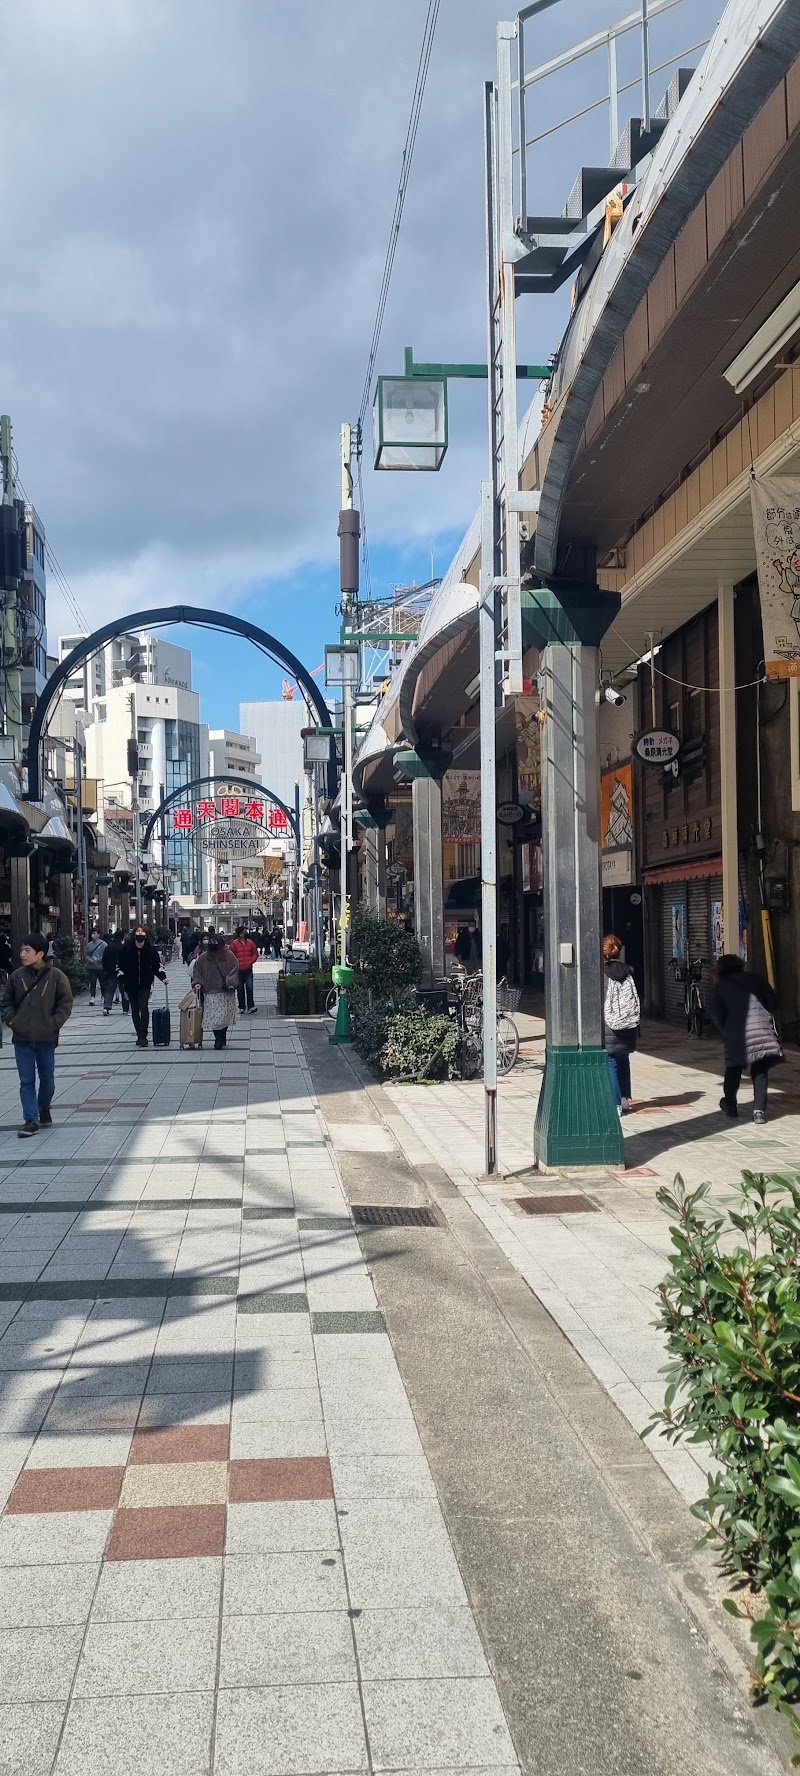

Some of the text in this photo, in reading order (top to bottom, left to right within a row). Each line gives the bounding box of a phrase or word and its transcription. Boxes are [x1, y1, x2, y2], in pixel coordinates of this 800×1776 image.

[164, 676, 189, 689] ADVANCE
[658, 736, 673, 745] メガネ
[173, 797, 288, 829] 通天閣本通
[210, 827, 251, 836] OSAKA
[202, 839, 259, 849] SHINSEKAI
